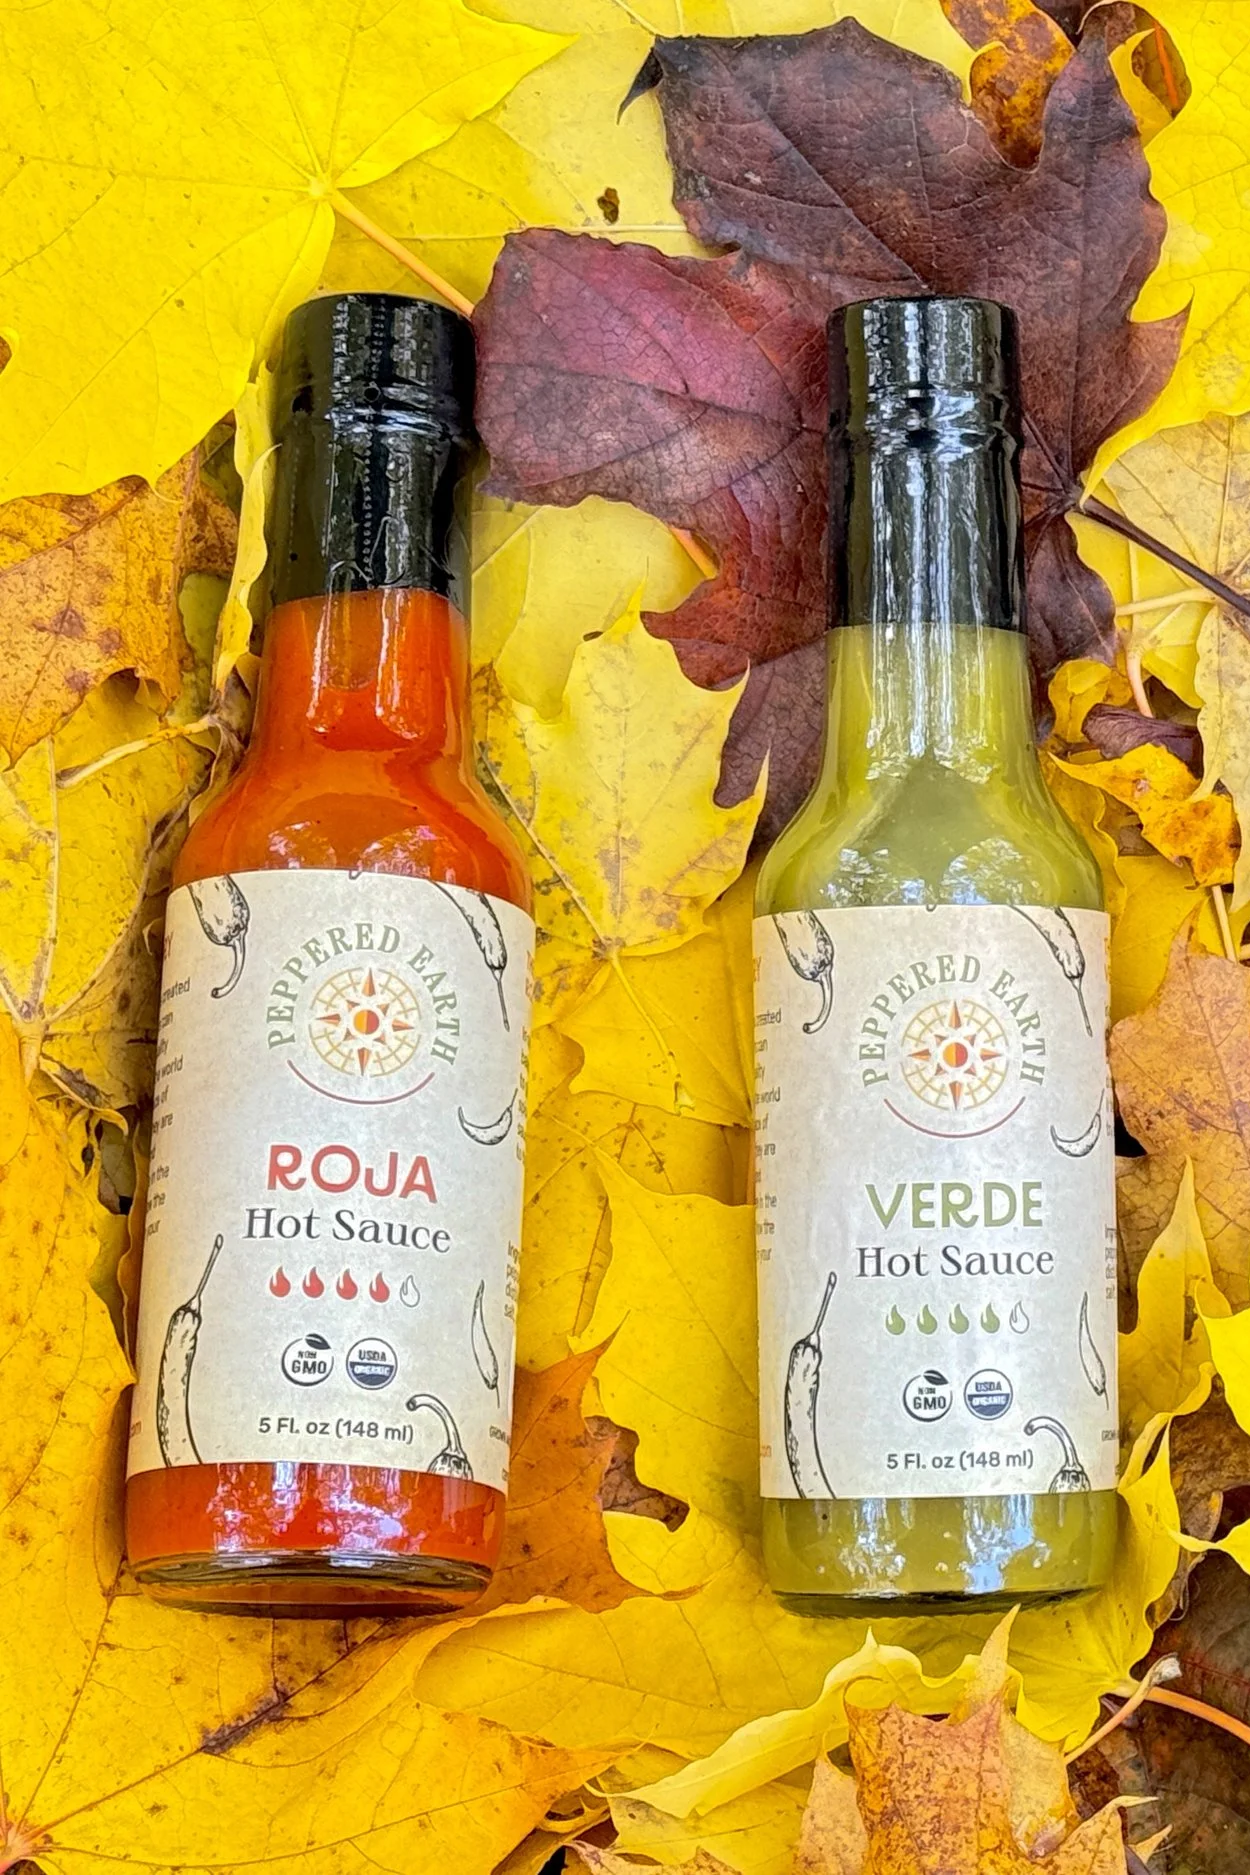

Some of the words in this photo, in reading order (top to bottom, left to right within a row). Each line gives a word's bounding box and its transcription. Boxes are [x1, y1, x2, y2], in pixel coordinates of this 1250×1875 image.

[266, 922, 401, 1050] PEPPERED
[407, 944, 461, 1065] EARTH
[858, 954, 981, 1087] PEPPERED
[988, 970, 1046, 1086] EARTH
[266, 1144, 439, 1204] ROJA
[865, 1181, 1044, 1230] VERDE
[242, 1207, 321, 1241] Hot
[331, 1209, 452, 1254] Sauce
[855, 1246, 929, 1278] Hot
[939, 1245, 1055, 1277] Sauce
[291, 1359, 327, 1375] GMO
[297, 1350, 317, 1359] NON
[358, 1349, 387, 1362] USDA
[918, 1387, 936, 1395] NON
[975, 1381, 1002, 1392] USDA
[913, 1395, 947, 1410] GMO
[258, 1417, 271, 1434] 5
[276, 1417, 300, 1435] Fl.
[305, 1421, 329, 1436] oz
[334, 1417, 379, 1439] (148
[384, 1424, 414, 1445] ml)
[886, 1453, 898, 1469] 5
[904, 1452, 927, 1470] Fl.
[931, 1455, 954, 1469] oz
[959, 1450, 1000, 1471] (148
[1005, 1448, 1034, 1469] ml)
